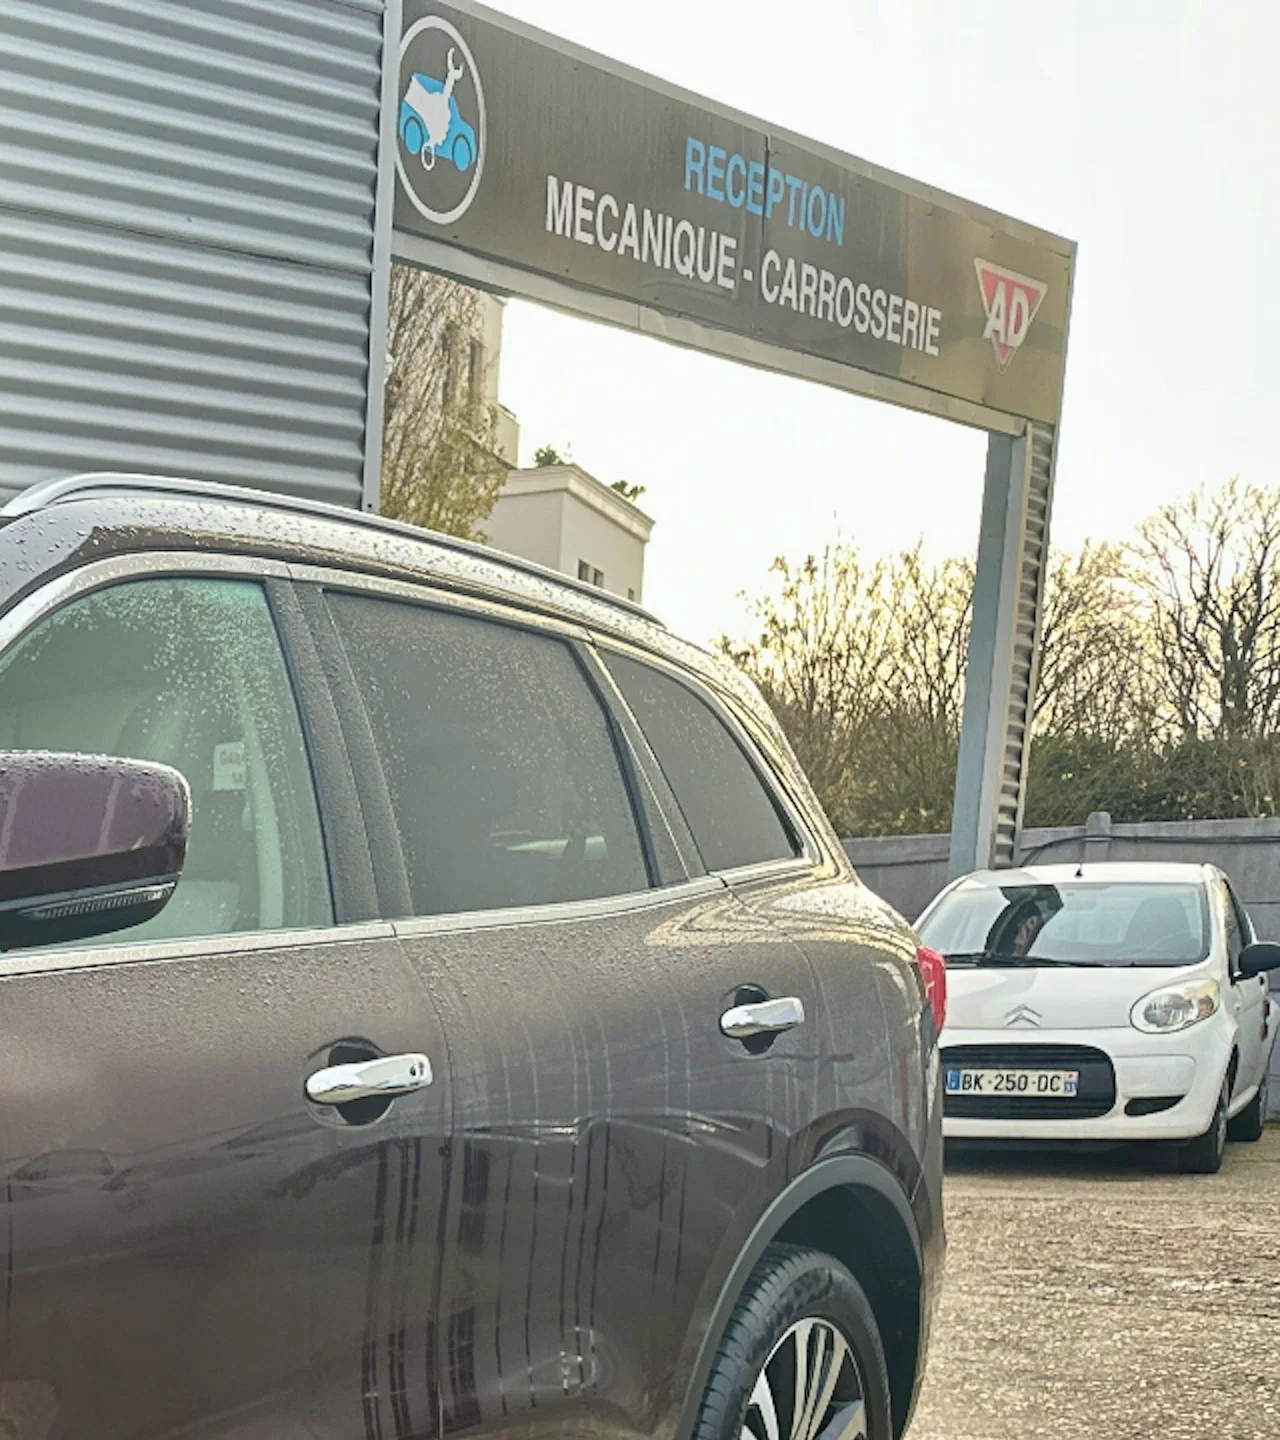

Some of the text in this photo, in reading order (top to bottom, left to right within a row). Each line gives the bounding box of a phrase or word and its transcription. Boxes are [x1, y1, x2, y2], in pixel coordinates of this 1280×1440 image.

[684, 136, 845, 245] RECEPTION
[545, 174, 737, 290] MECANIQUE
[761, 248, 941, 357] CARROSSERIE
[983, 280, 1030, 349] AD
